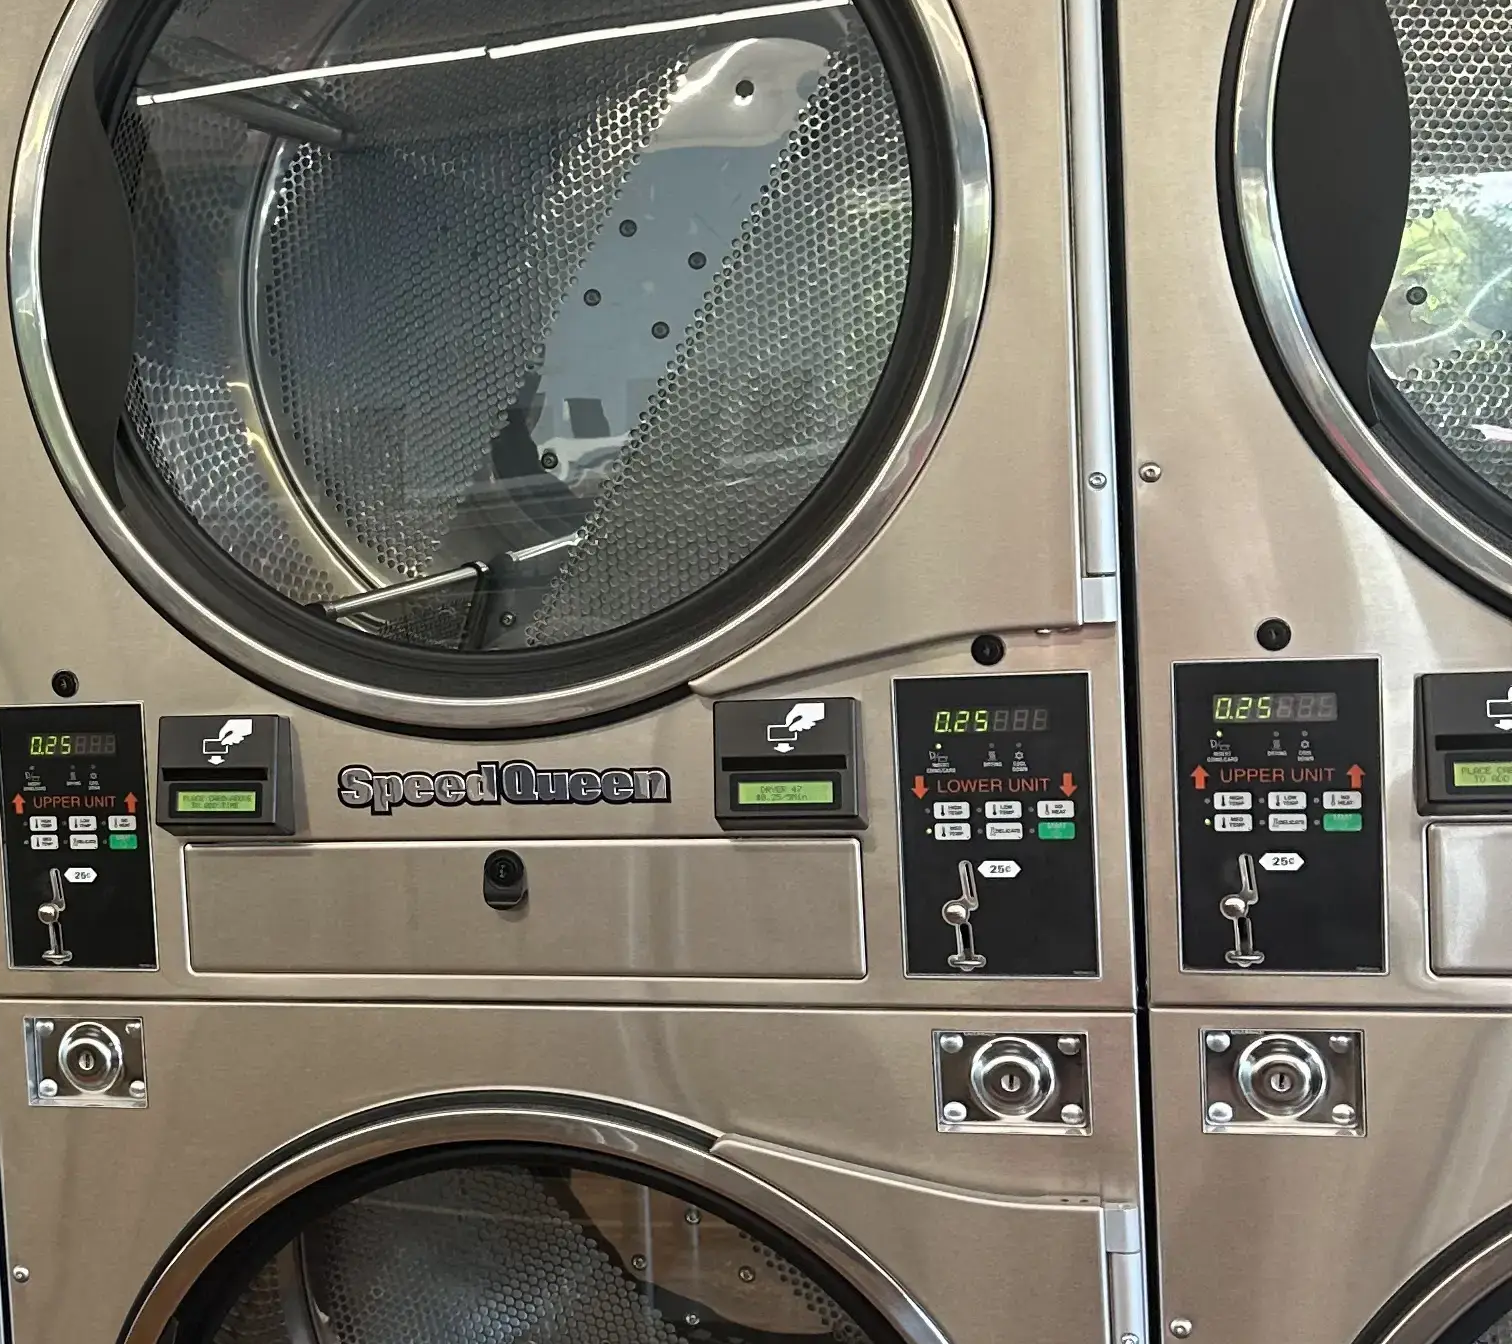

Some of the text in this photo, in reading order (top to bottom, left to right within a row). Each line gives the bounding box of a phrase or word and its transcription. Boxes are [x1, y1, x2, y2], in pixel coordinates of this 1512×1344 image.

[1215, 697, 1271, 720] 0.25
[934, 710, 989, 733] 0.25
[30, 735, 71, 755] 0.25
[1220, 767, 1336, 783] UPPER UNIT
[937, 777, 1051, 793] LOWER UNIT
[32, 795, 117, 809] UPPER UNIT
[1272, 856, 1295, 866] 25¢
[989, 865, 1012, 874] 25¢
